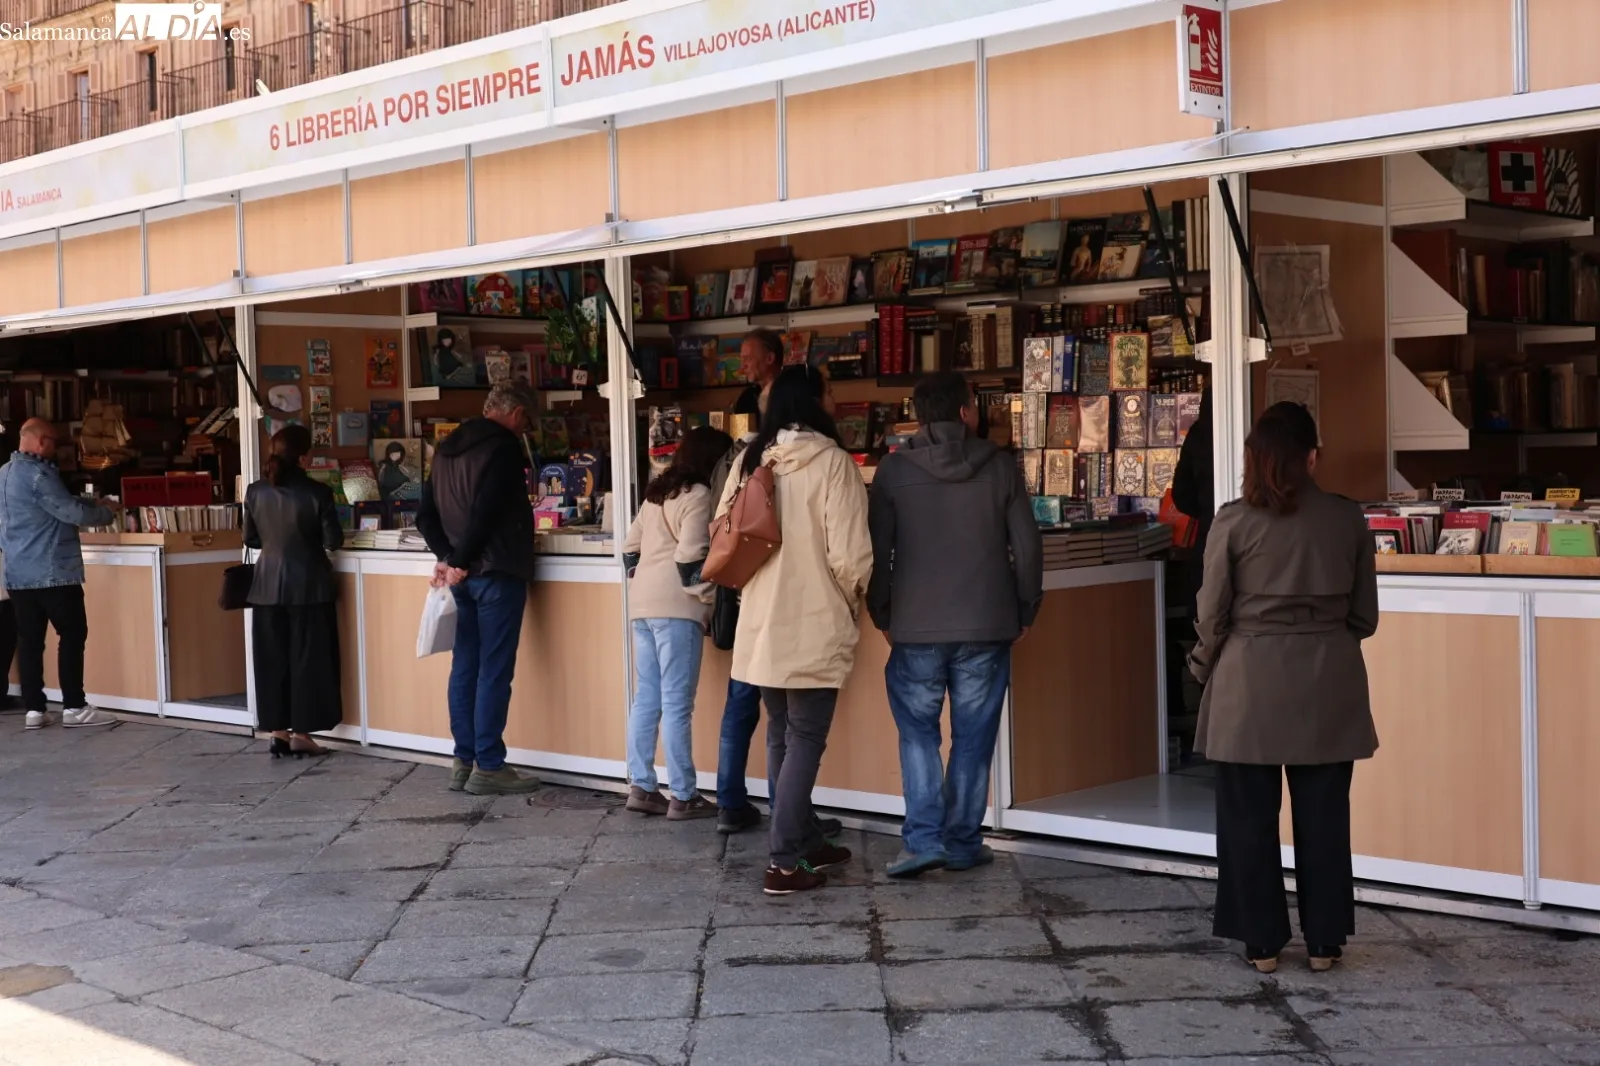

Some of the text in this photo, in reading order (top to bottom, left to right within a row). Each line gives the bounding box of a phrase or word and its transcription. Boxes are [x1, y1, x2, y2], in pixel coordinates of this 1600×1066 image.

[560, 0, 876, 86] JAMÁS VILLAJOYOSA (ALICANTE)
[269, 62, 541, 150] 6 LIBRERÍA POR SIEMPRE
[1191, 83, 1220, 95] EXTINTOR
[17, 187, 62, 209] SALAMANCA
